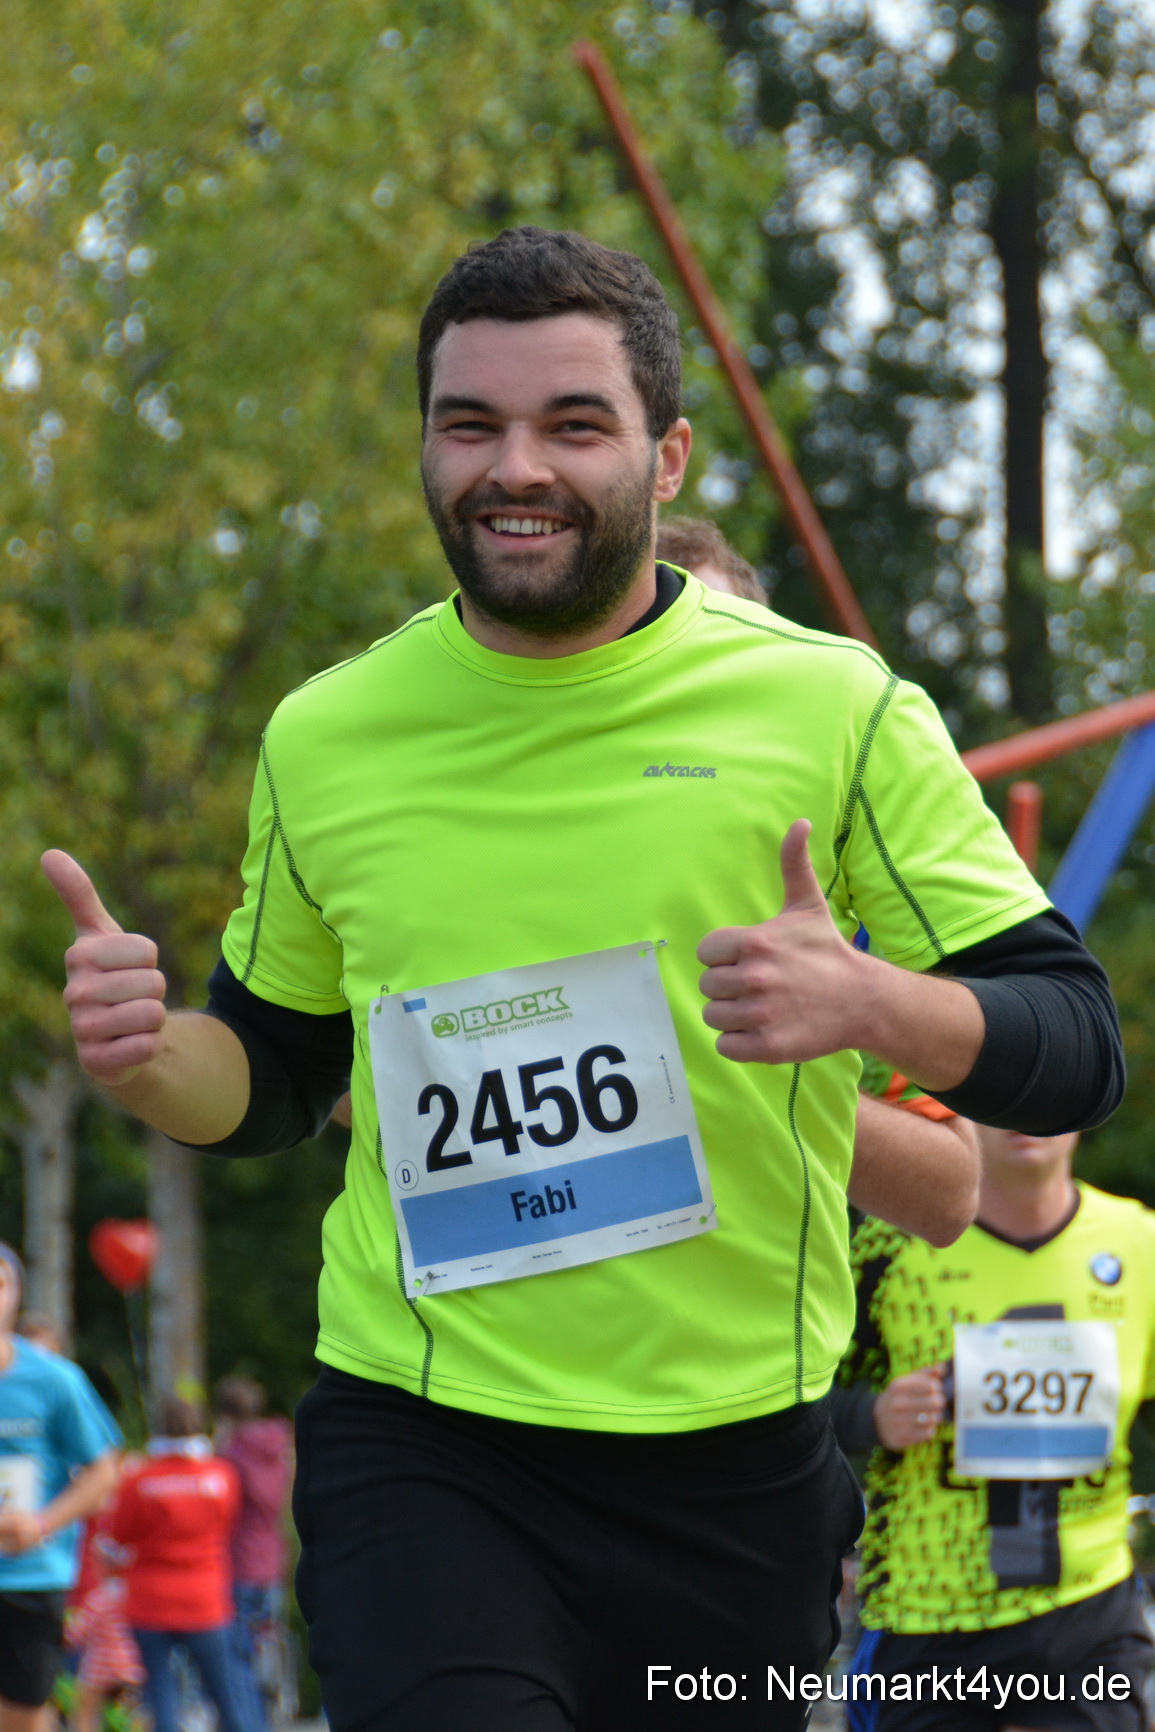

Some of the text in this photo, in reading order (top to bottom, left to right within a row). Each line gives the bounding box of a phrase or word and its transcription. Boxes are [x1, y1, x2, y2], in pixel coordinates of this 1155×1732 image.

[459, 986, 571, 1034] BOCK
[464, 1011, 574, 1043] inspired by smart concepts
[417, 1044, 639, 1174] 2456
[401, 1168, 412, 1185] D
[510, 1179, 578, 1223] Fabi
[982, 1369, 1096, 1415] 3297
